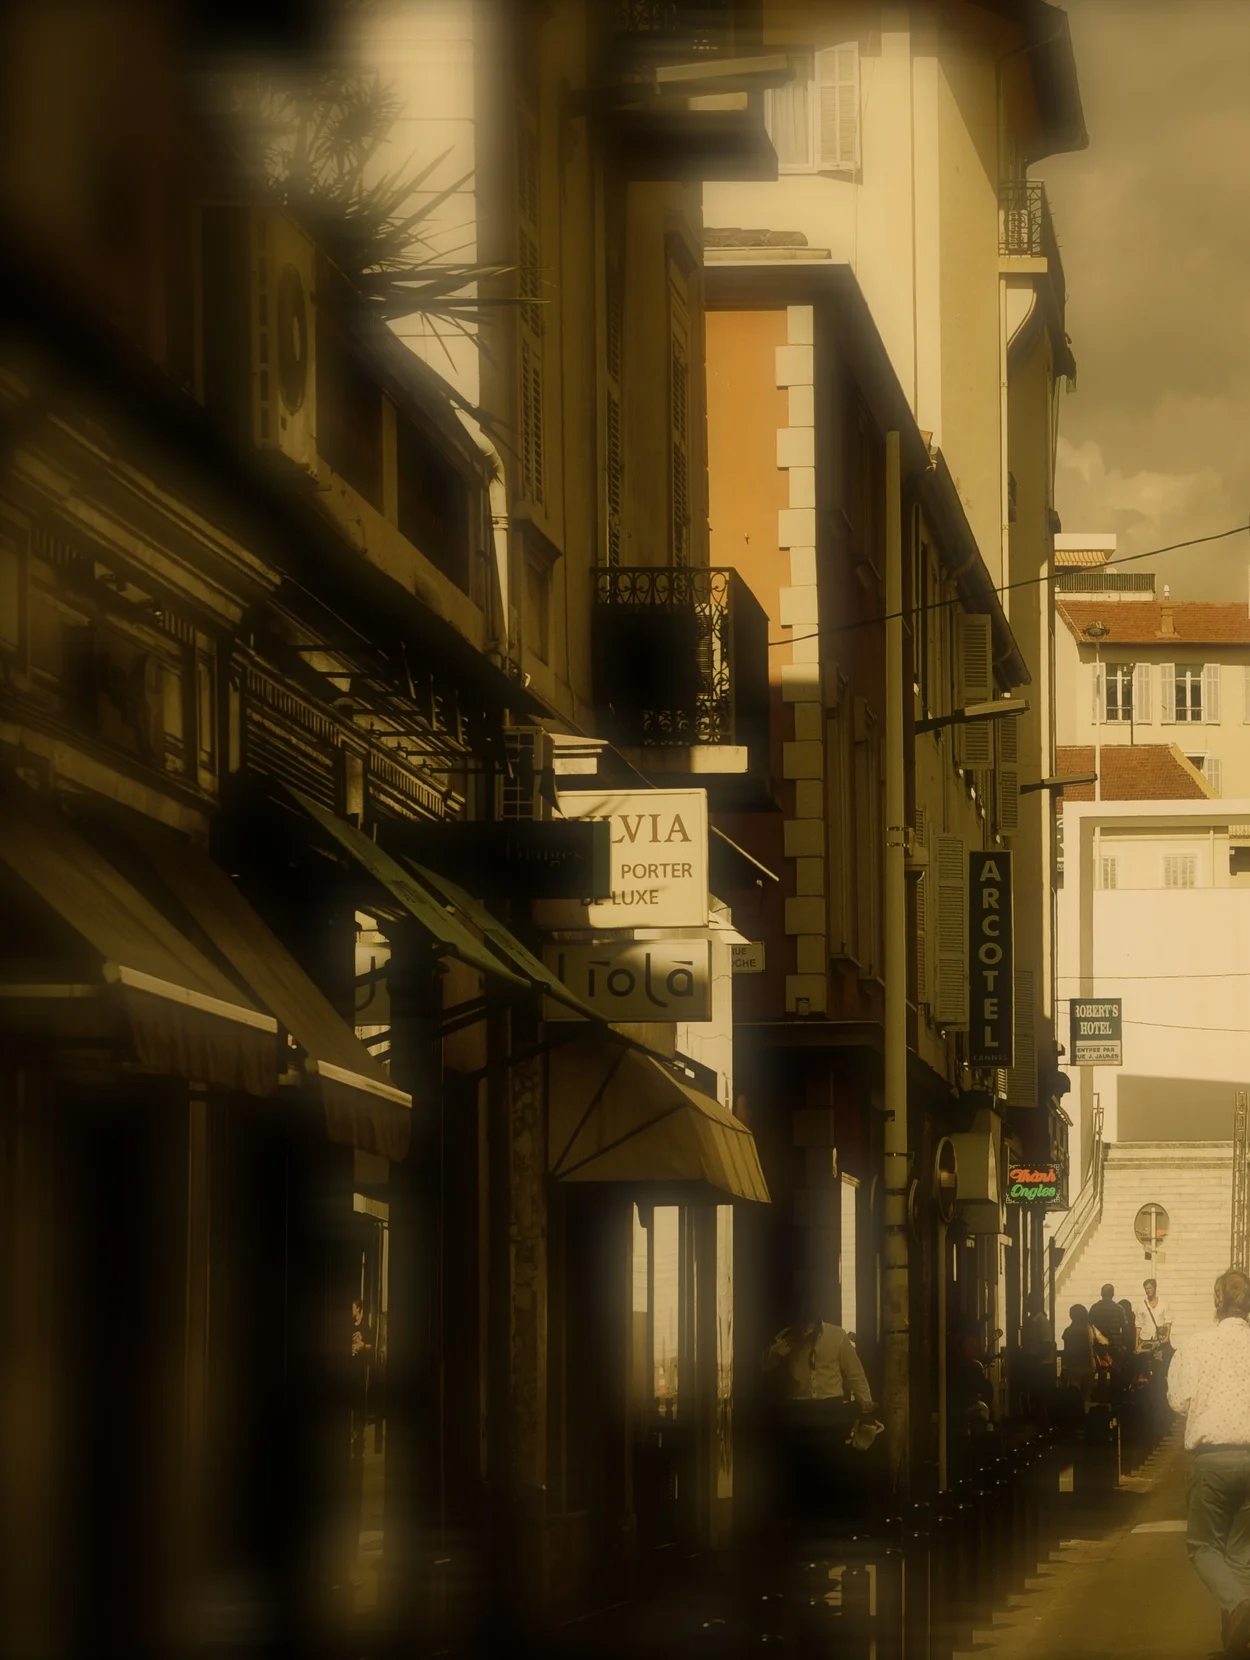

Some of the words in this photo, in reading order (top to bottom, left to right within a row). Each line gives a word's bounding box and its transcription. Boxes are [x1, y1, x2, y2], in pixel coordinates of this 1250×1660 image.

[621, 862, 693, 880] PORTER
[612, 889, 659, 906] LUXE
[978, 859, 1003, 1048] ARCOTEL
[1075, 1004, 1119, 1018] ROBERT'S
[1080, 1021, 1112, 1035] HOTEL
[1011, 1184, 1056, 1200] Ongles
